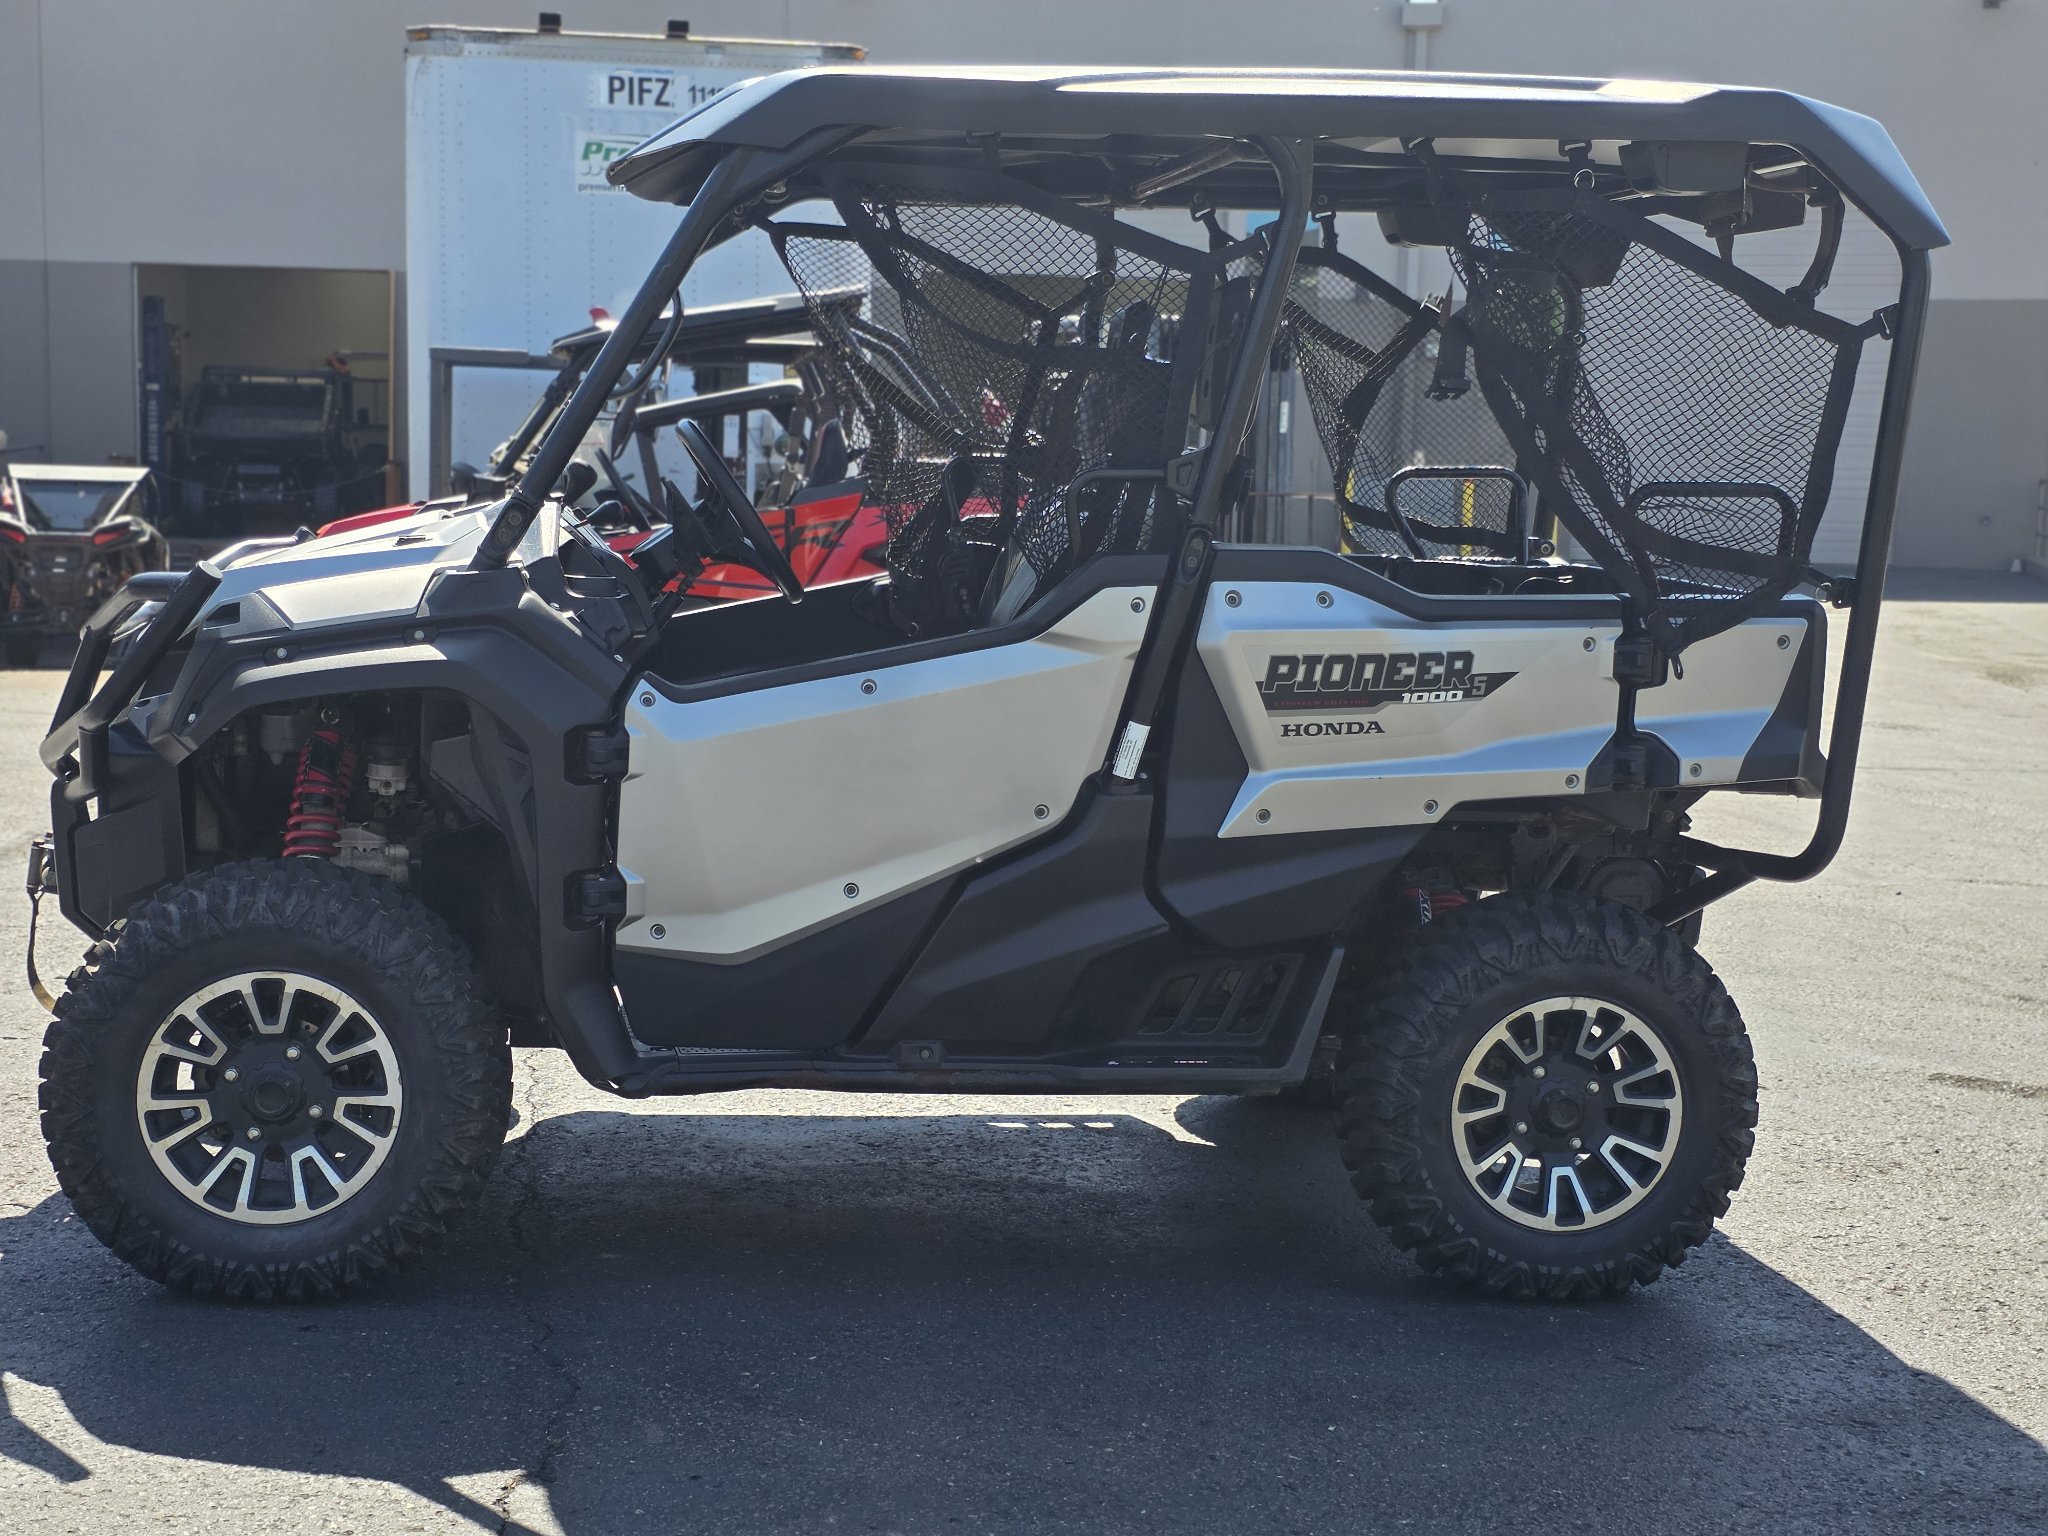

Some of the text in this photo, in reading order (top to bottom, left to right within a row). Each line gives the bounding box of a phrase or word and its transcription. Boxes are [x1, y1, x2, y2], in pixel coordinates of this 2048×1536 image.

[608, 75, 670, 107] PIFZ
[1263, 651, 1474, 692] PIONEER
[1402, 690, 1463, 704] 1000
[1280, 720, 1385, 737] HONDA
